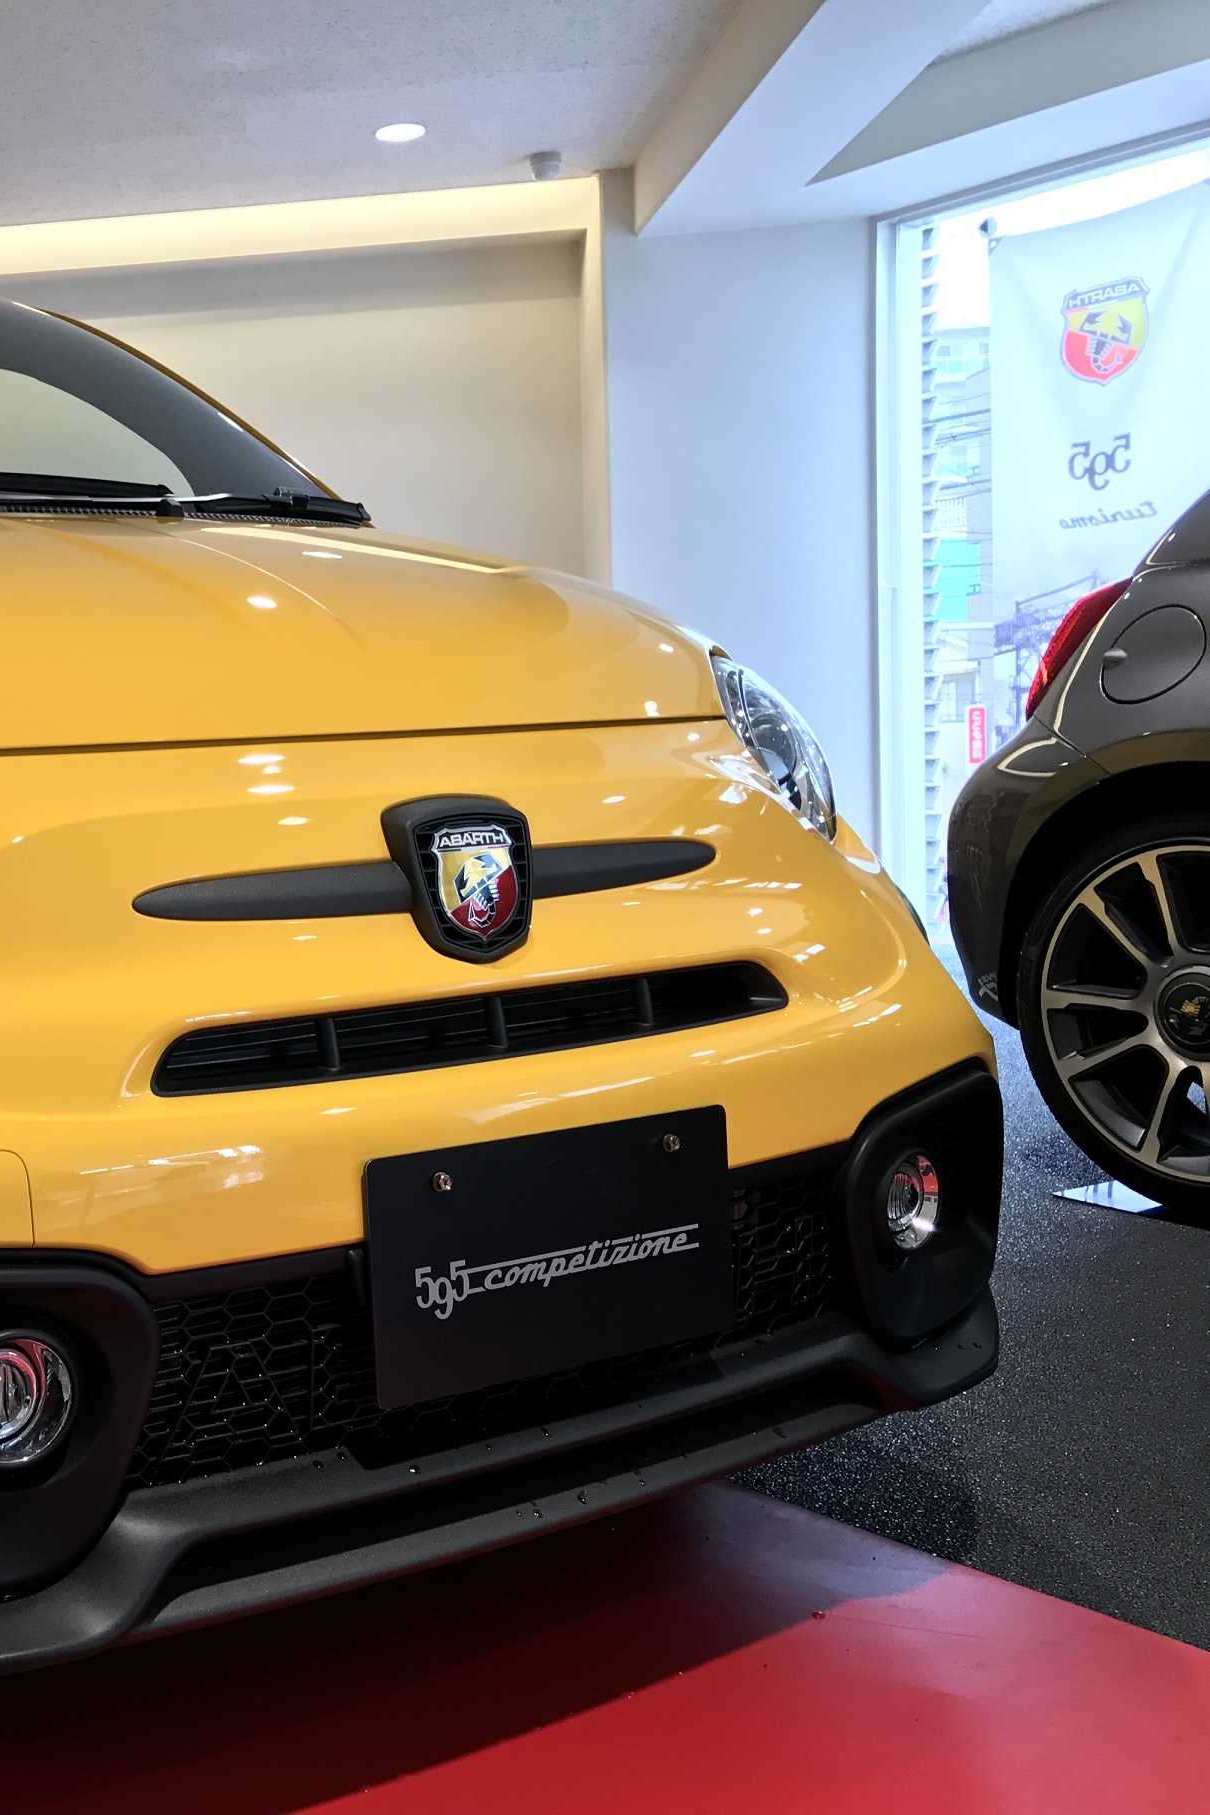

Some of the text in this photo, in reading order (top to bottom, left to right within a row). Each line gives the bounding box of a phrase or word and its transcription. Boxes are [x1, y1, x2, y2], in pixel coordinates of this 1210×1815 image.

[439, 832, 504, 848] ABARTH
[415, 1223, 699, 1320] 595 competizione
